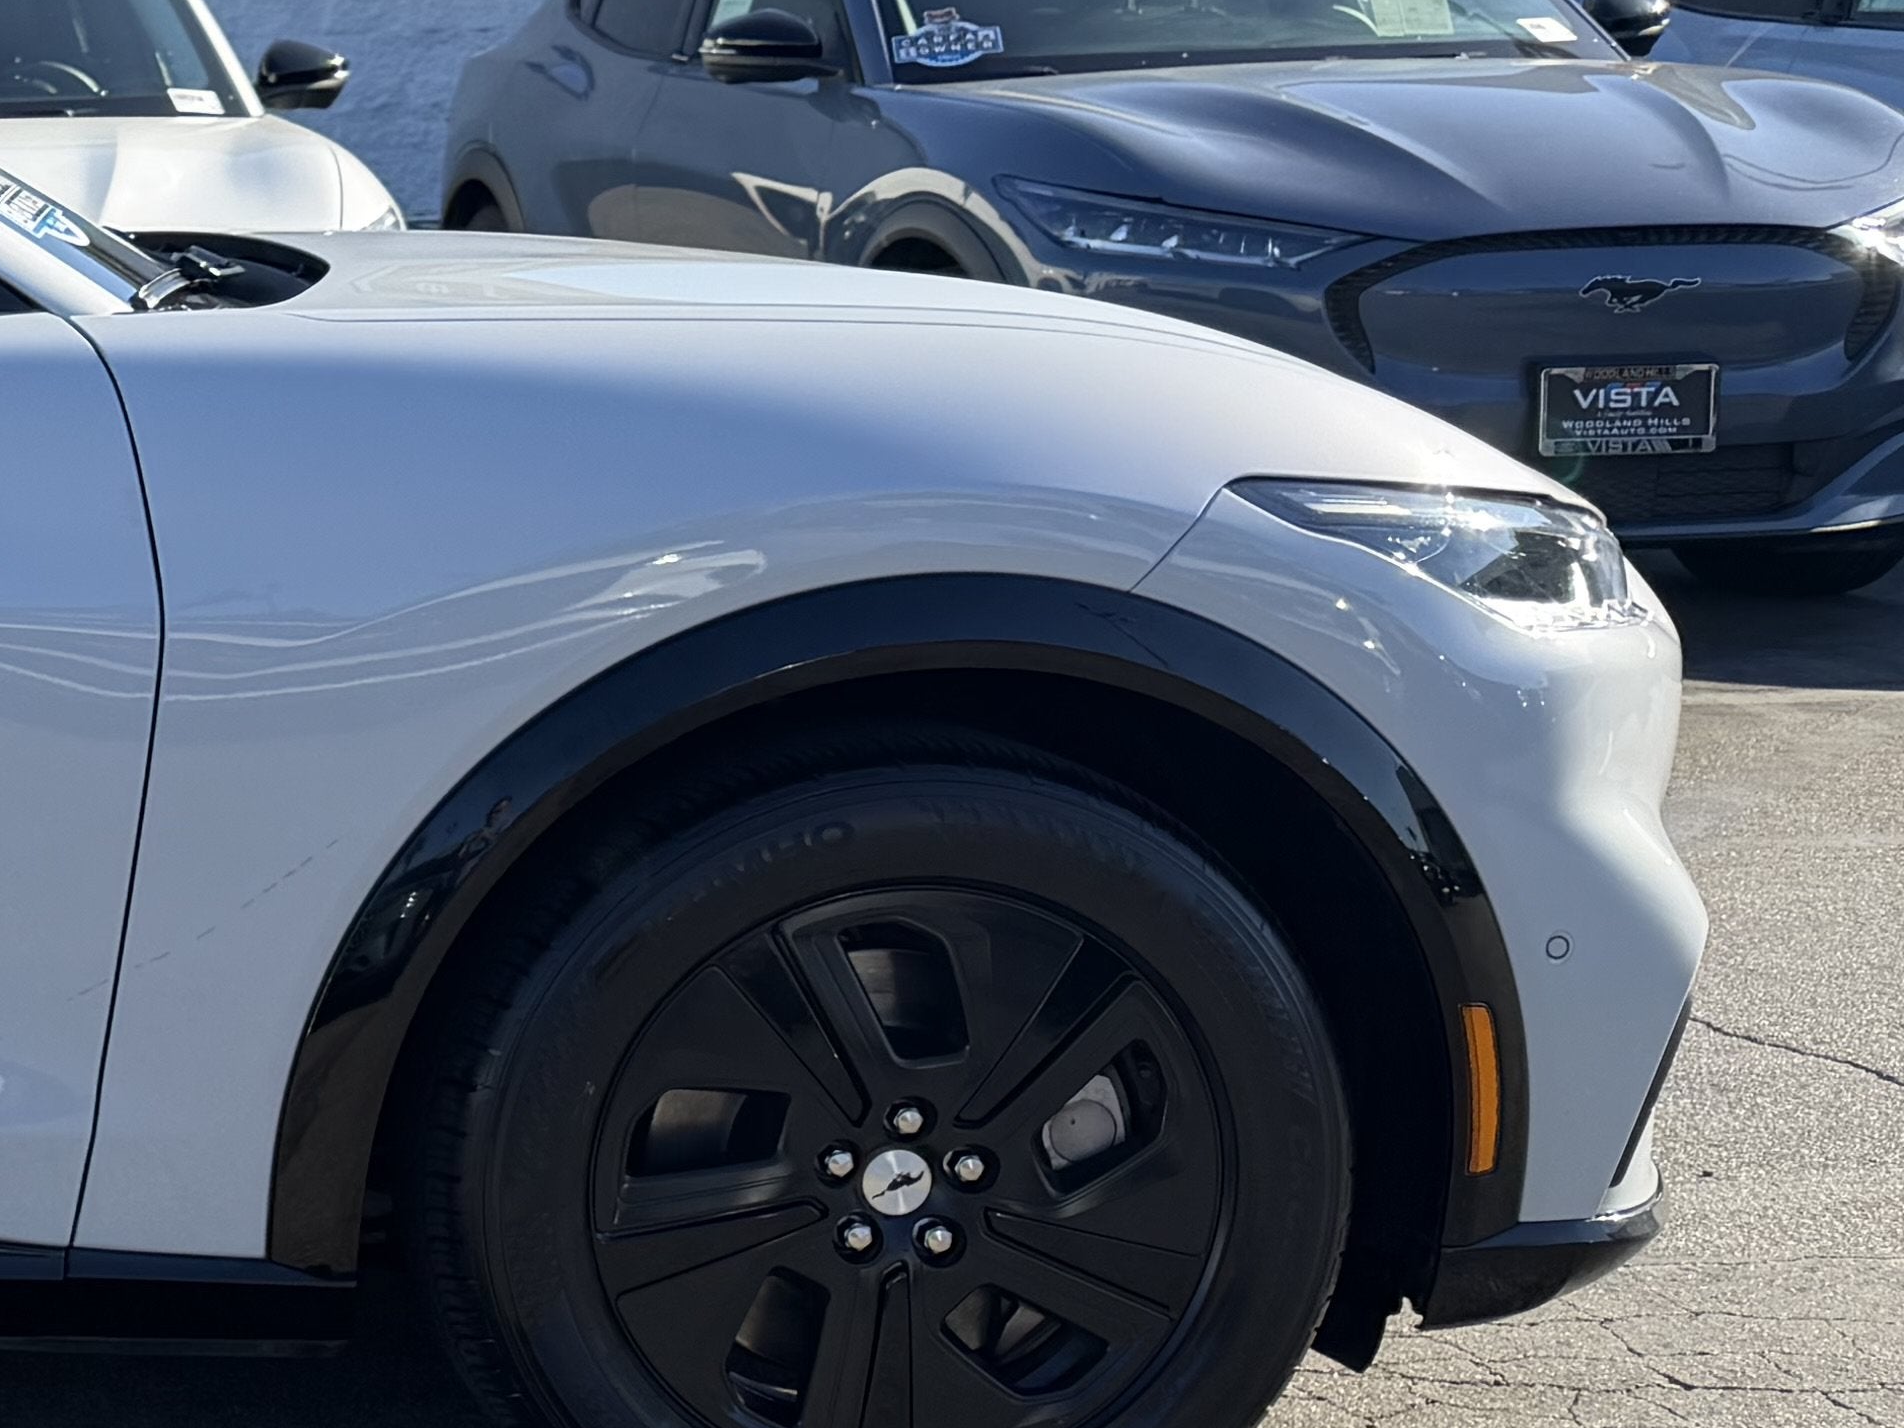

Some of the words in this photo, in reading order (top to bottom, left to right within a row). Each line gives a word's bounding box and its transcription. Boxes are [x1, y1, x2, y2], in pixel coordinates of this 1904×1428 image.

[1573, 386, 1680, 409] VISTA
[1562, 419, 1642, 430] WOODLAND
[1647, 416, 1691, 427] HILLS
[1587, 439, 1653, 453] VISTA
